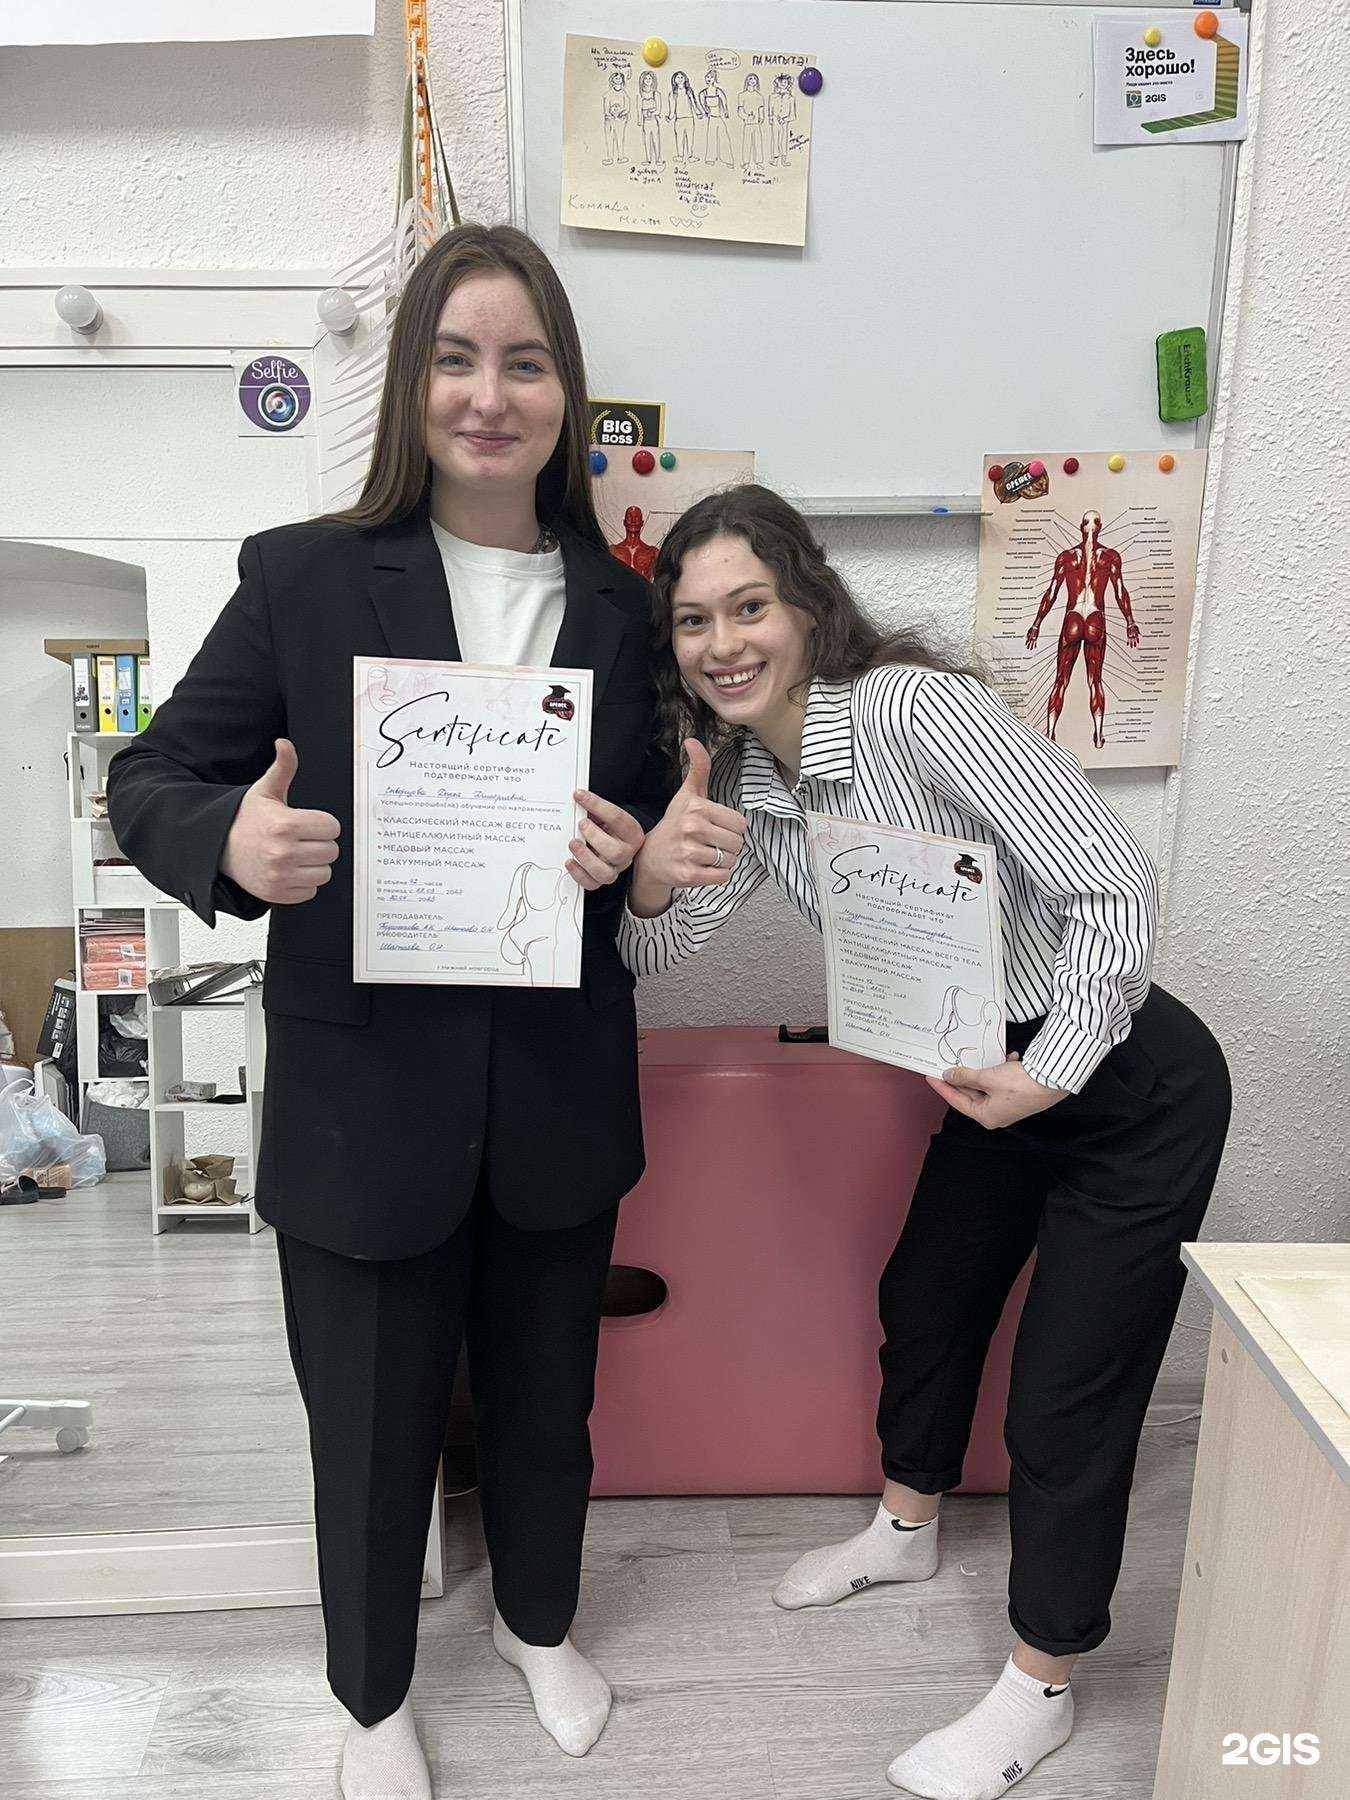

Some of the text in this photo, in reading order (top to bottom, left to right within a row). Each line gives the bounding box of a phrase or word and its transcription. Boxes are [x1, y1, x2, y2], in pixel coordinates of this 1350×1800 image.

[1125, 46, 1176, 63] Здесь
[1125, 59, 1195, 78] хорошо!
[1145, 93, 1167, 103] 2GIS
[251, 359, 299, 383] Selfie
[602, 419, 633, 434] BIG
[601, 434, 633, 444] BOSS
[409, 761, 535, 774] Настоящий сертификат
[424, 772, 499, 782] подтверждает
[383, 816, 562, 831] КЛАССИЧЕСКИЙ МАССАЖ ВСЕГО ТЕЛА
[383, 830, 526, 843] АНТИЦЕЛЛЮЛИТНЫЙ МАССАЖ
[383, 844, 475, 855] МЕДОВЫЙ МАССАЖ
[383, 857, 486, 869] ВАКУУМНЫЙ МАССАЖ
[962, 957, 982, 968] ТЕЛА
[850, 1575, 871, 1591] NIKE
[1001, 1760, 1023, 1784] NIKE
